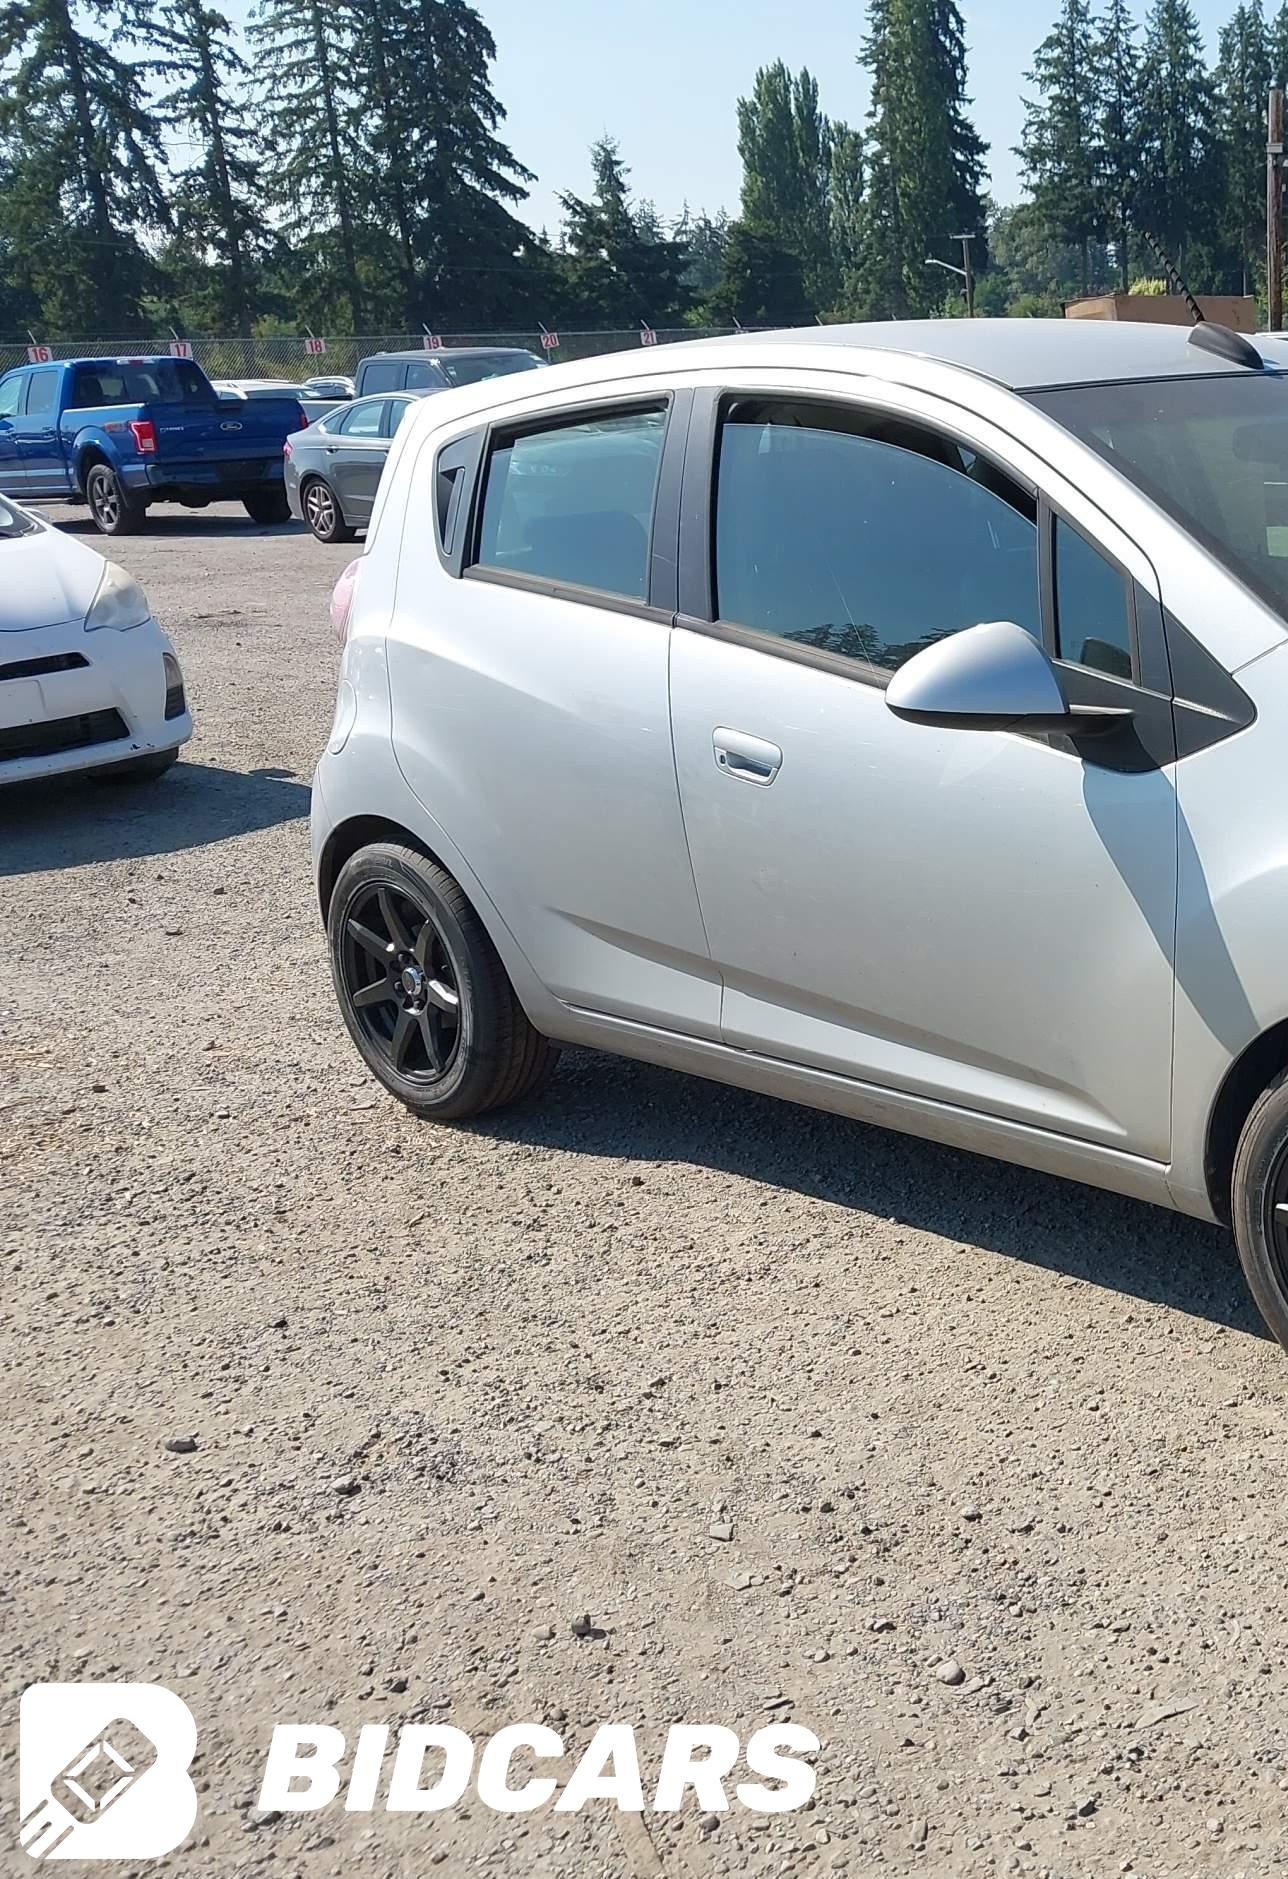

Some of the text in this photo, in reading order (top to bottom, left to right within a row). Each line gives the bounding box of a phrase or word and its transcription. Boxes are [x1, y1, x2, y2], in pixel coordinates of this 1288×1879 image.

[425, 337, 439, 349] 19
[542, 335, 557, 347] 20
[643, 333, 654, 344] 21
[173, 343, 187, 357] 17
[309, 340, 321, 352] 18
[31, 347, 49, 362] 16
